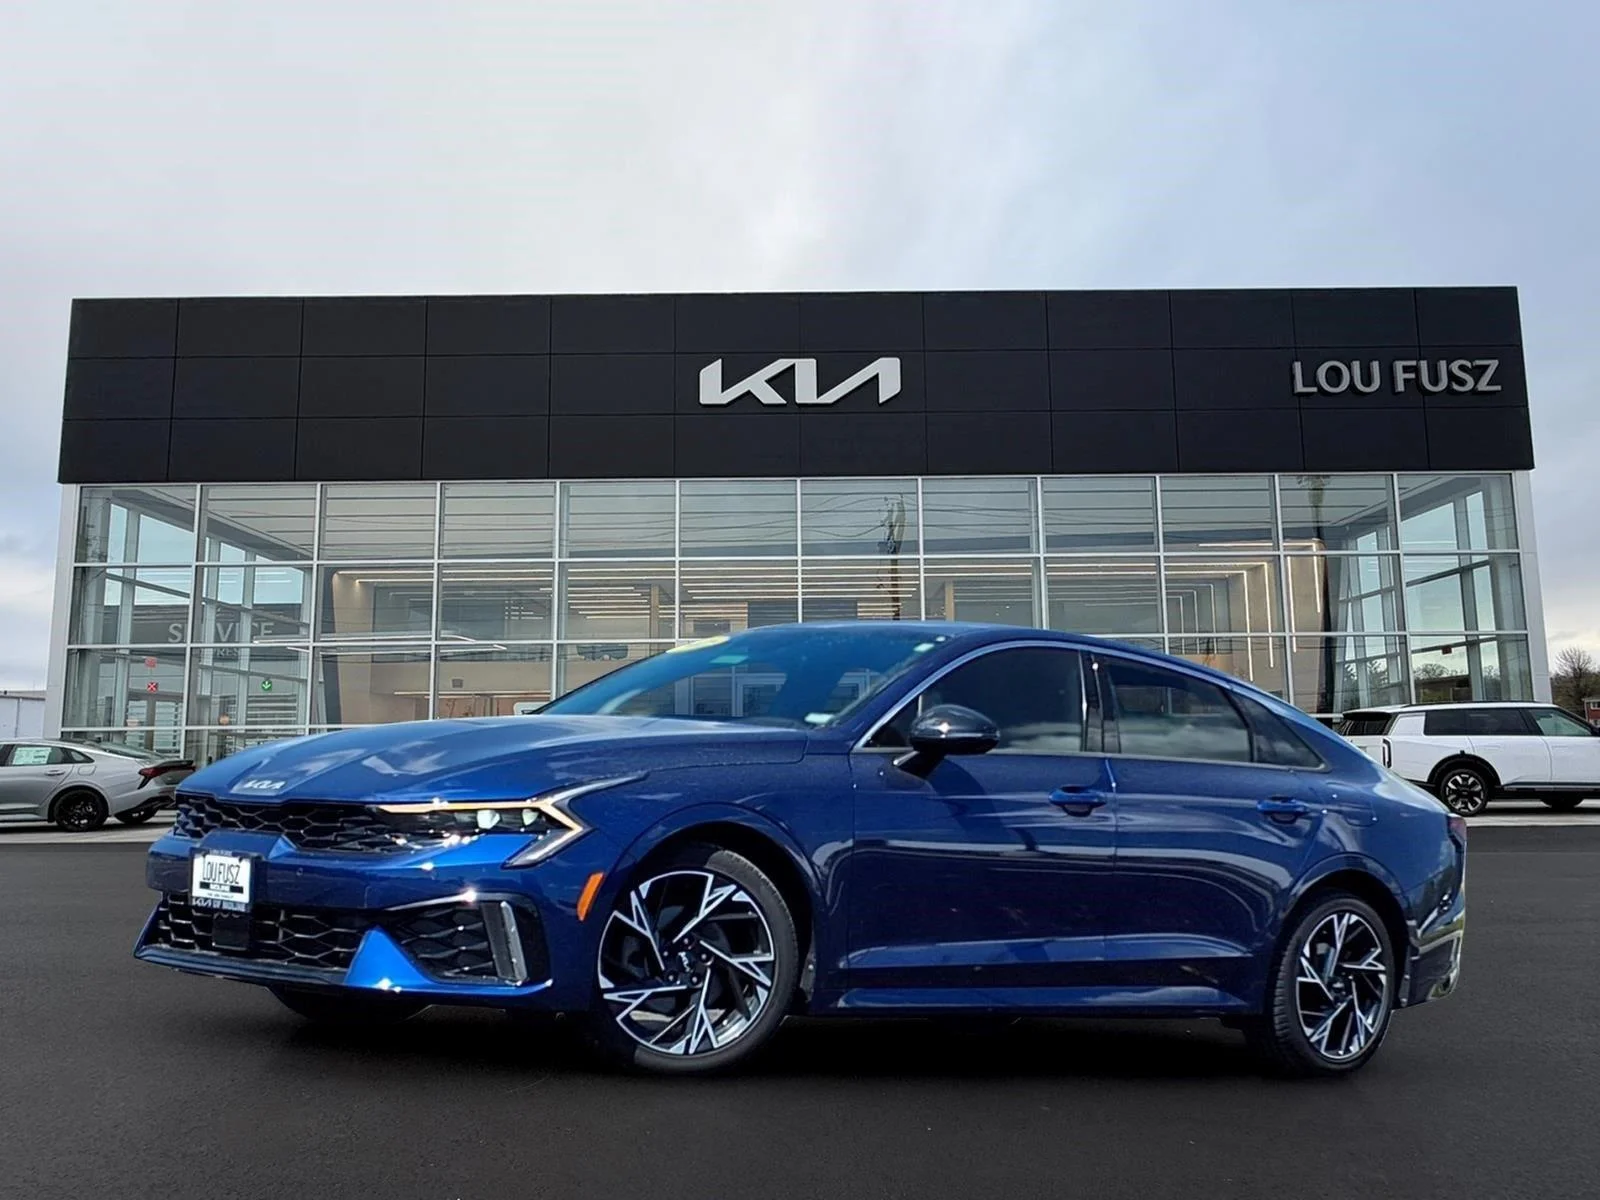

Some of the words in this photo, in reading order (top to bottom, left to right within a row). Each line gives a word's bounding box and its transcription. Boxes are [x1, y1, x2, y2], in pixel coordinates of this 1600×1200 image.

[699, 357, 901, 405] KIA
[1292, 360, 1381, 393] LOU
[1393, 359, 1502, 393] FUSZ
